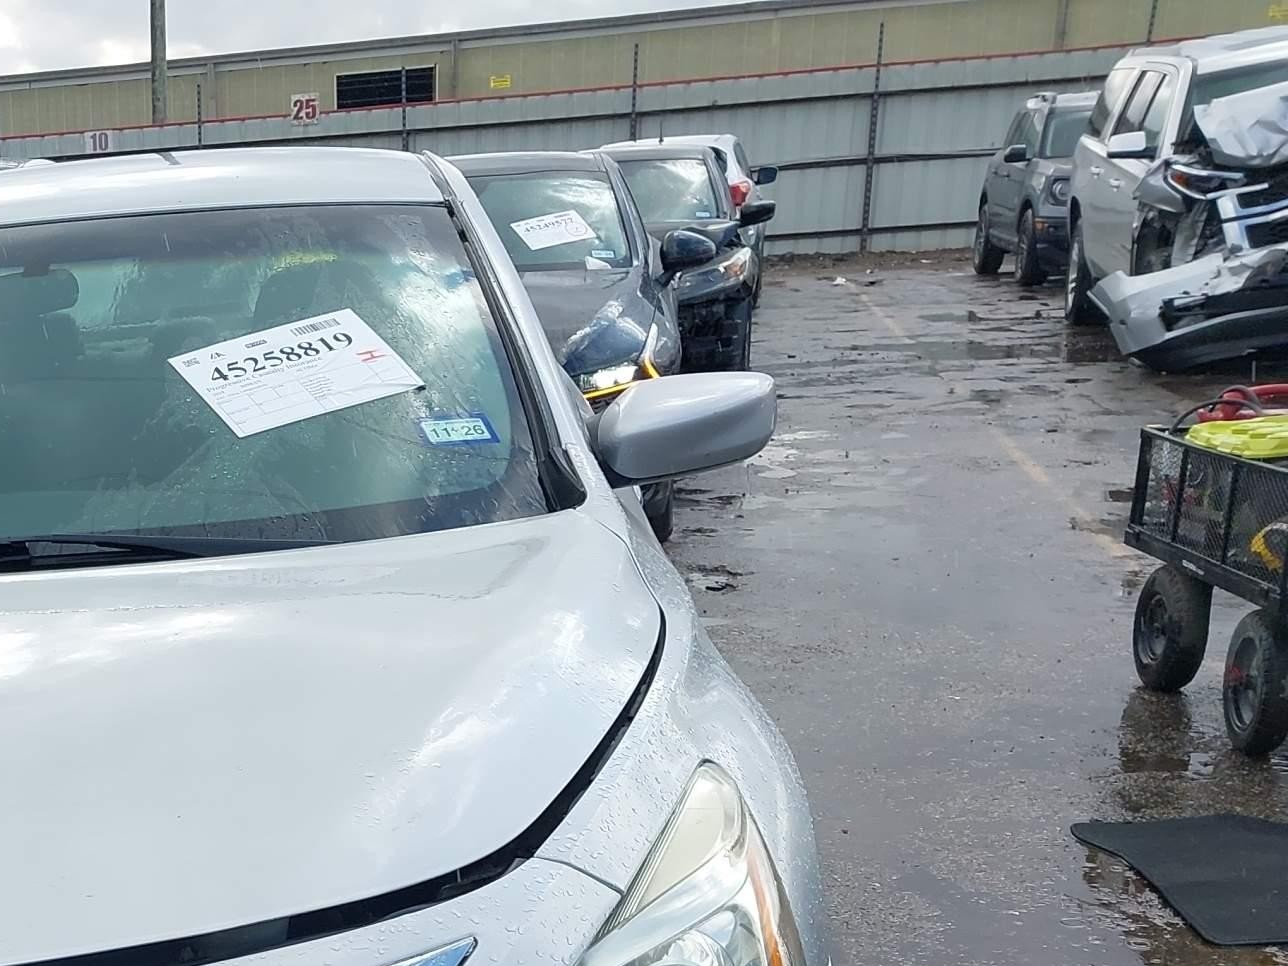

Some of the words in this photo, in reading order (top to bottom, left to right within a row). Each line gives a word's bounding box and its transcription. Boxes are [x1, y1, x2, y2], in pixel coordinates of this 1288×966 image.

[293, 98, 317, 121] 25
[90, 131, 109, 152] 10
[211, 332, 353, 381] 45258819
[461, 424, 486, 437] 26
